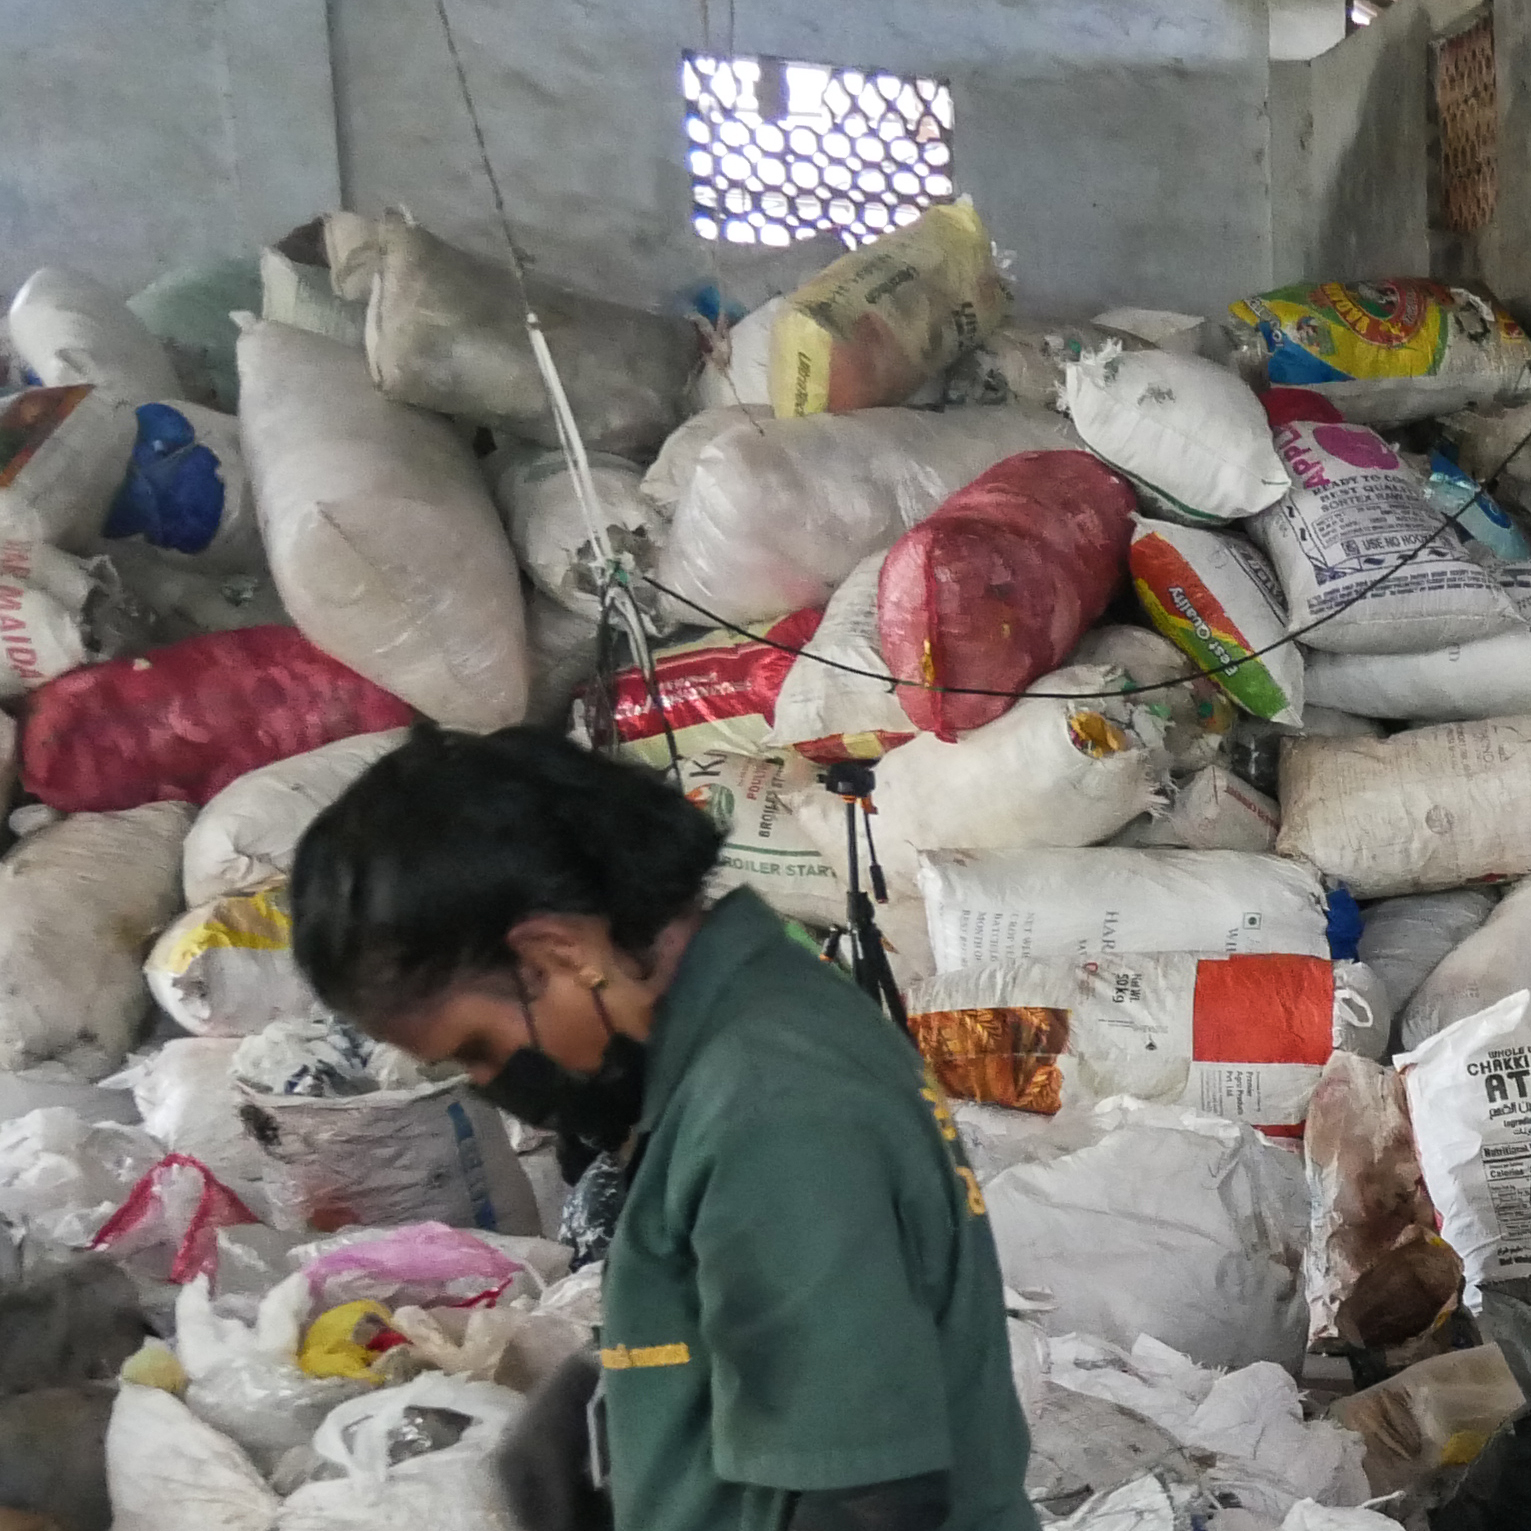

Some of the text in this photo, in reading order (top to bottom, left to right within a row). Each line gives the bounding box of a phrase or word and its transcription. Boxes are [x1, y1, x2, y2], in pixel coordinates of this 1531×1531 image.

[1362, 537, 1385, 551] USE
[1167, 585, 1211, 641] Quality
[719, 856, 781, 877] ROILER
[1466, 1054, 1531, 1077] CHAKKI
